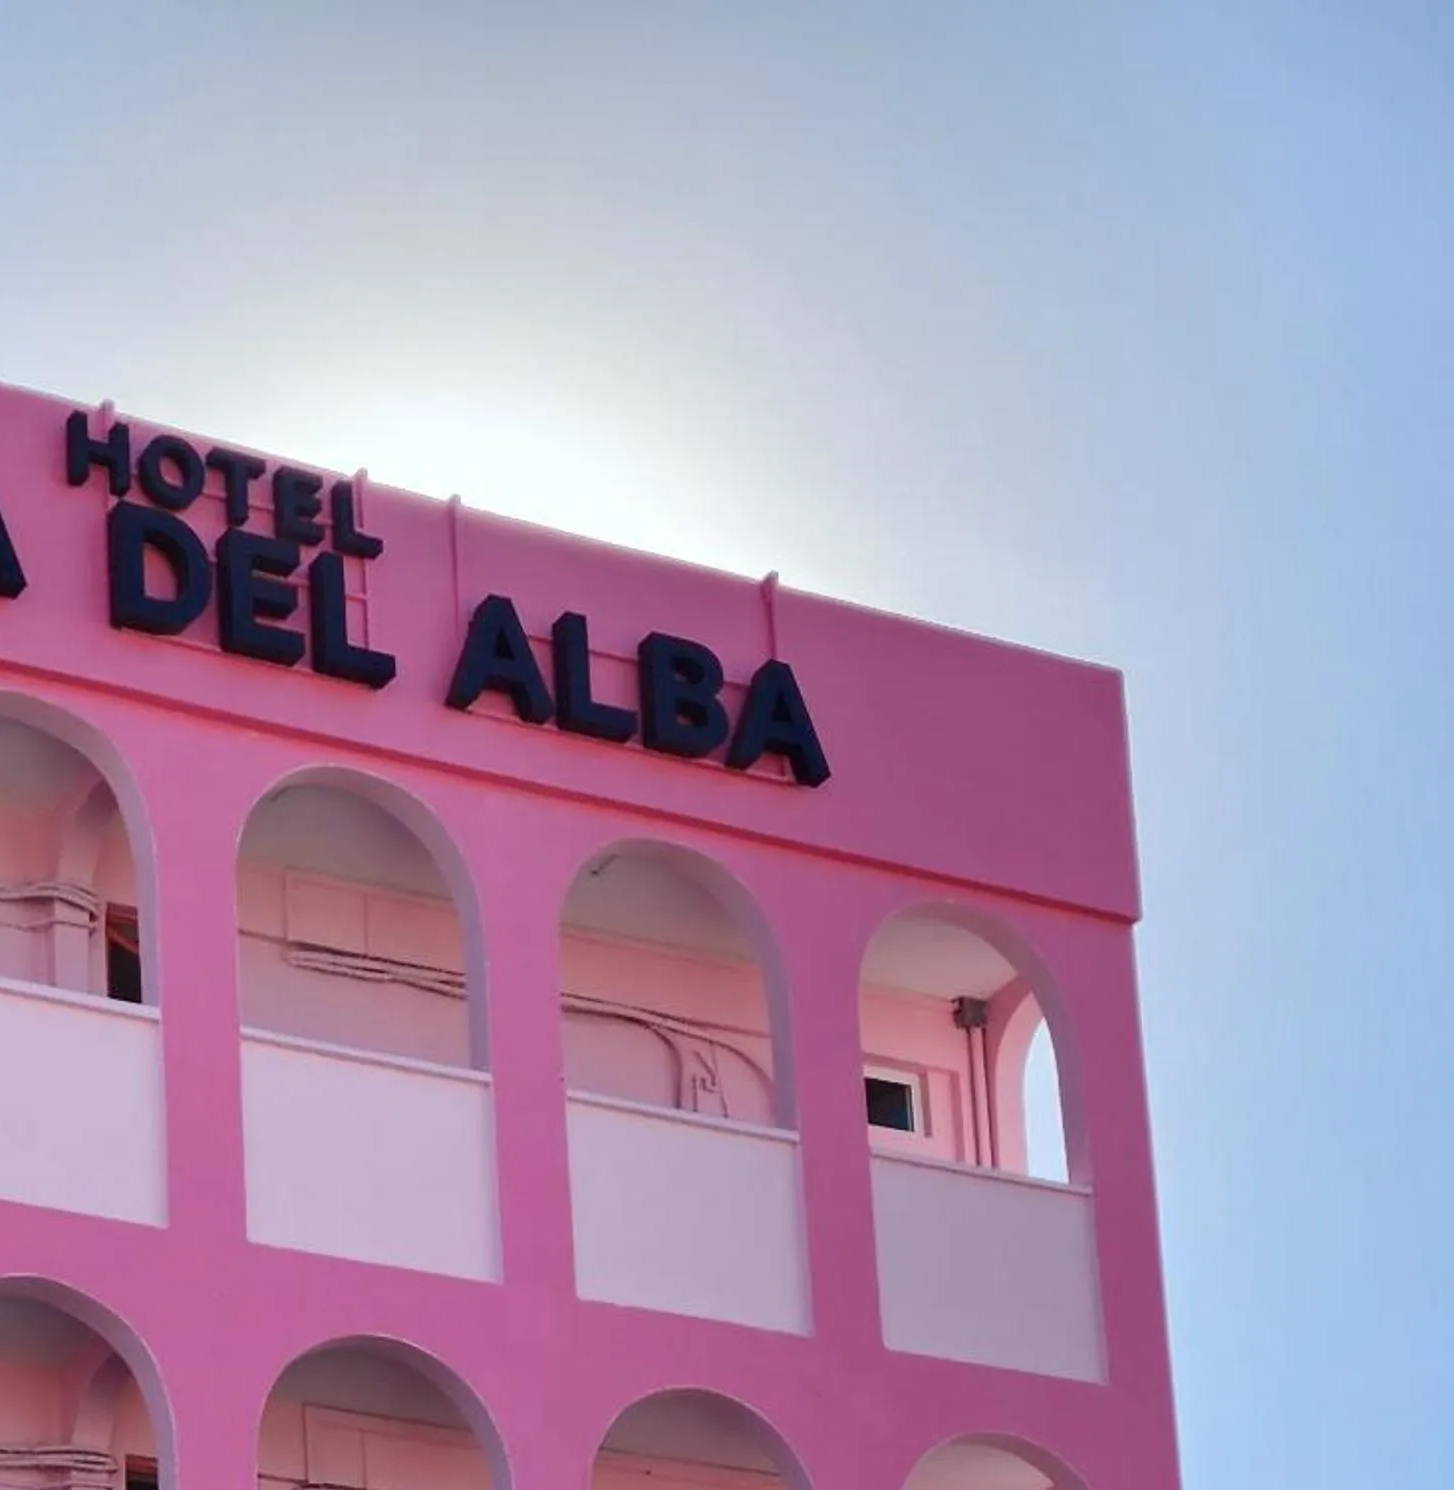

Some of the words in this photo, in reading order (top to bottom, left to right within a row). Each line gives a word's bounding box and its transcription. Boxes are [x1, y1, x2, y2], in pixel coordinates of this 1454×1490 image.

[65, 409, 384, 561] HOTEL
[109, 499, 397, 691] DEL
[445, 593, 833, 788] ALBA
